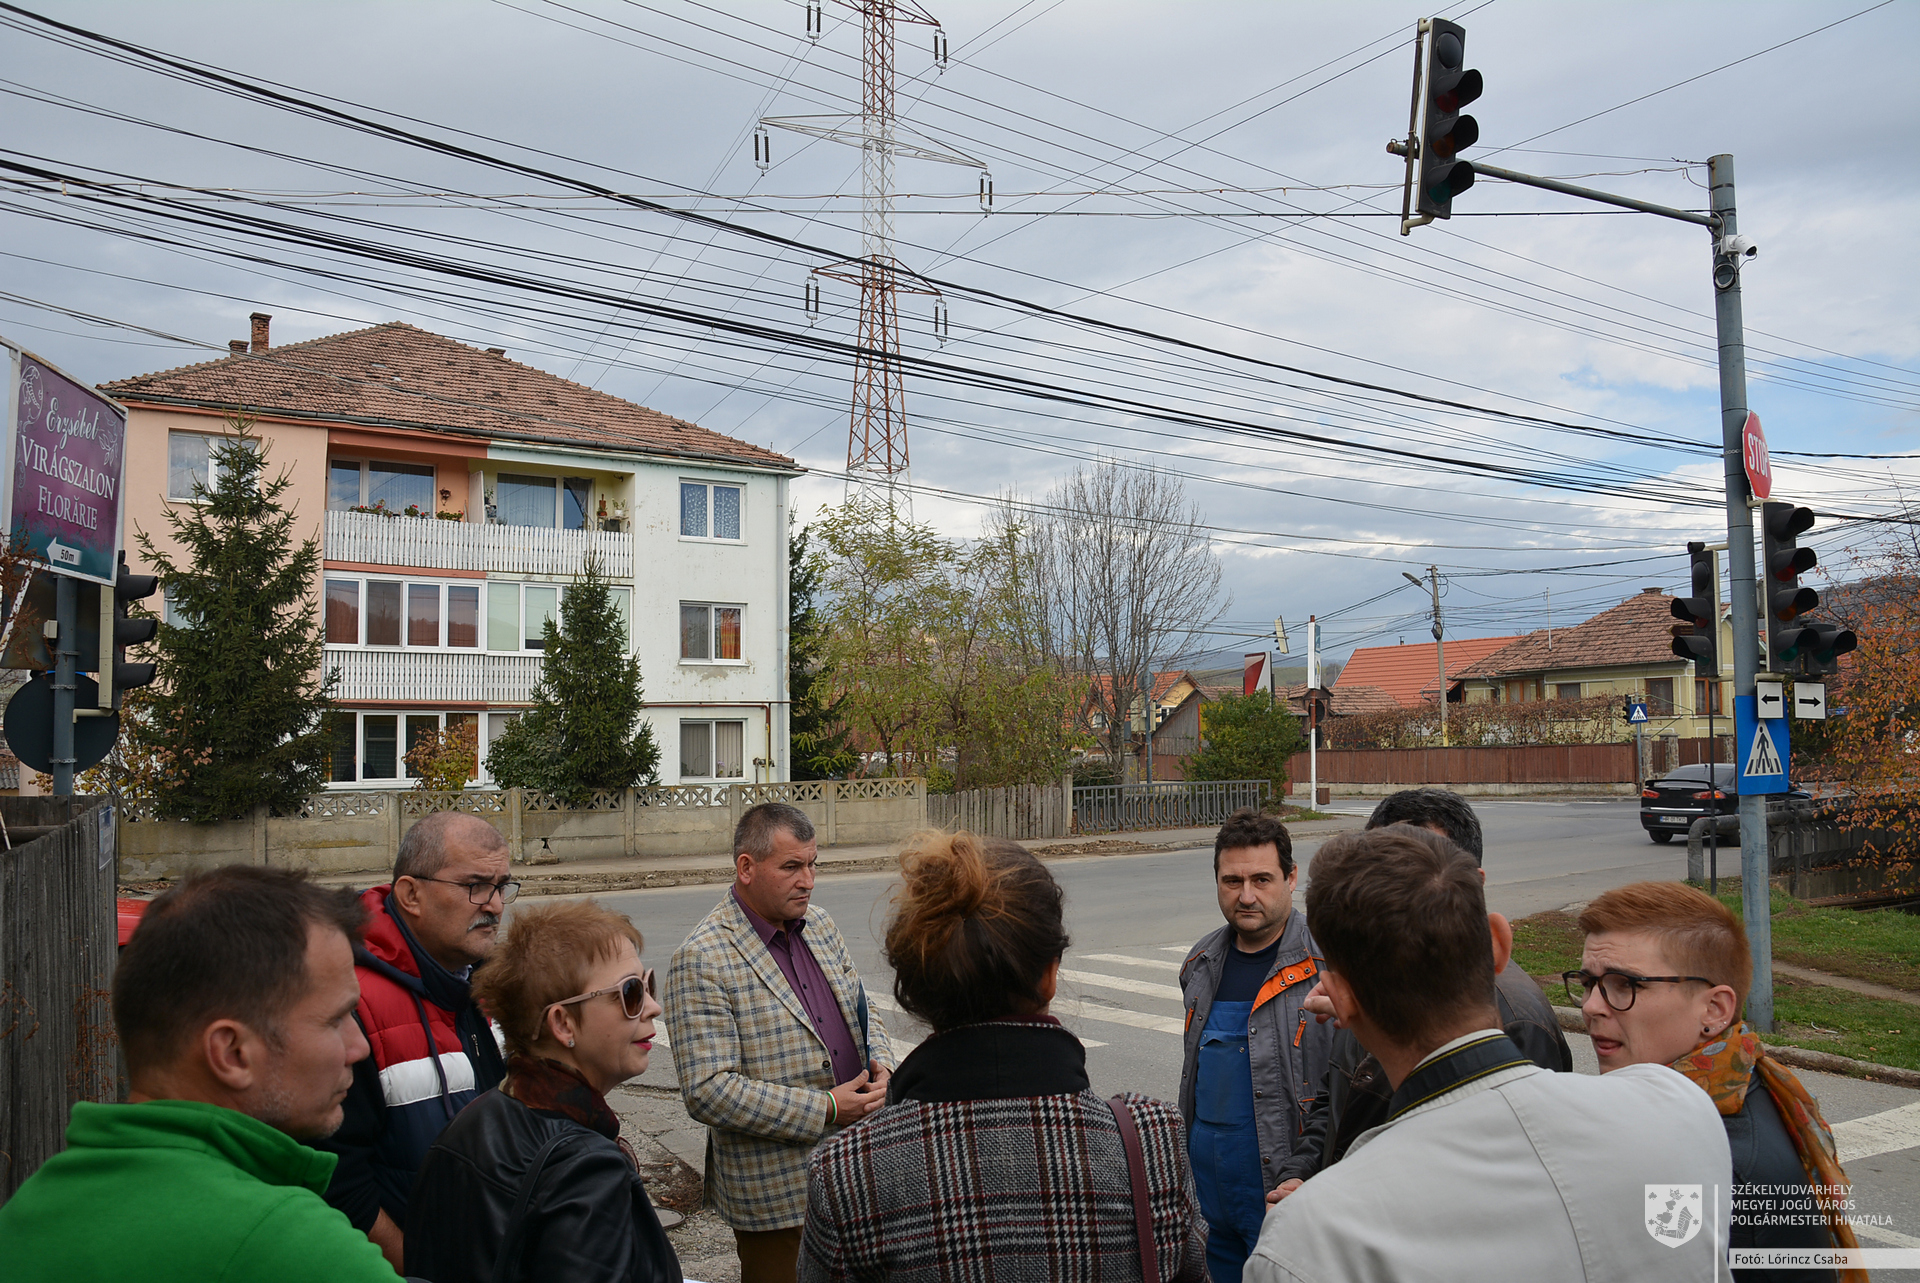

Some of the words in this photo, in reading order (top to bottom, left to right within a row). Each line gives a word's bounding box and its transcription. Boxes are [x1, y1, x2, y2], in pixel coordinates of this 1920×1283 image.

[46, 397, 100, 450] Erzsébet
[20, 434, 116, 501] VIRÁGSZALON
[1748, 433, 1768, 477] STOP
[37, 484, 98, 531] FLORĂRIE
[60, 548, 75, 563] 50m
